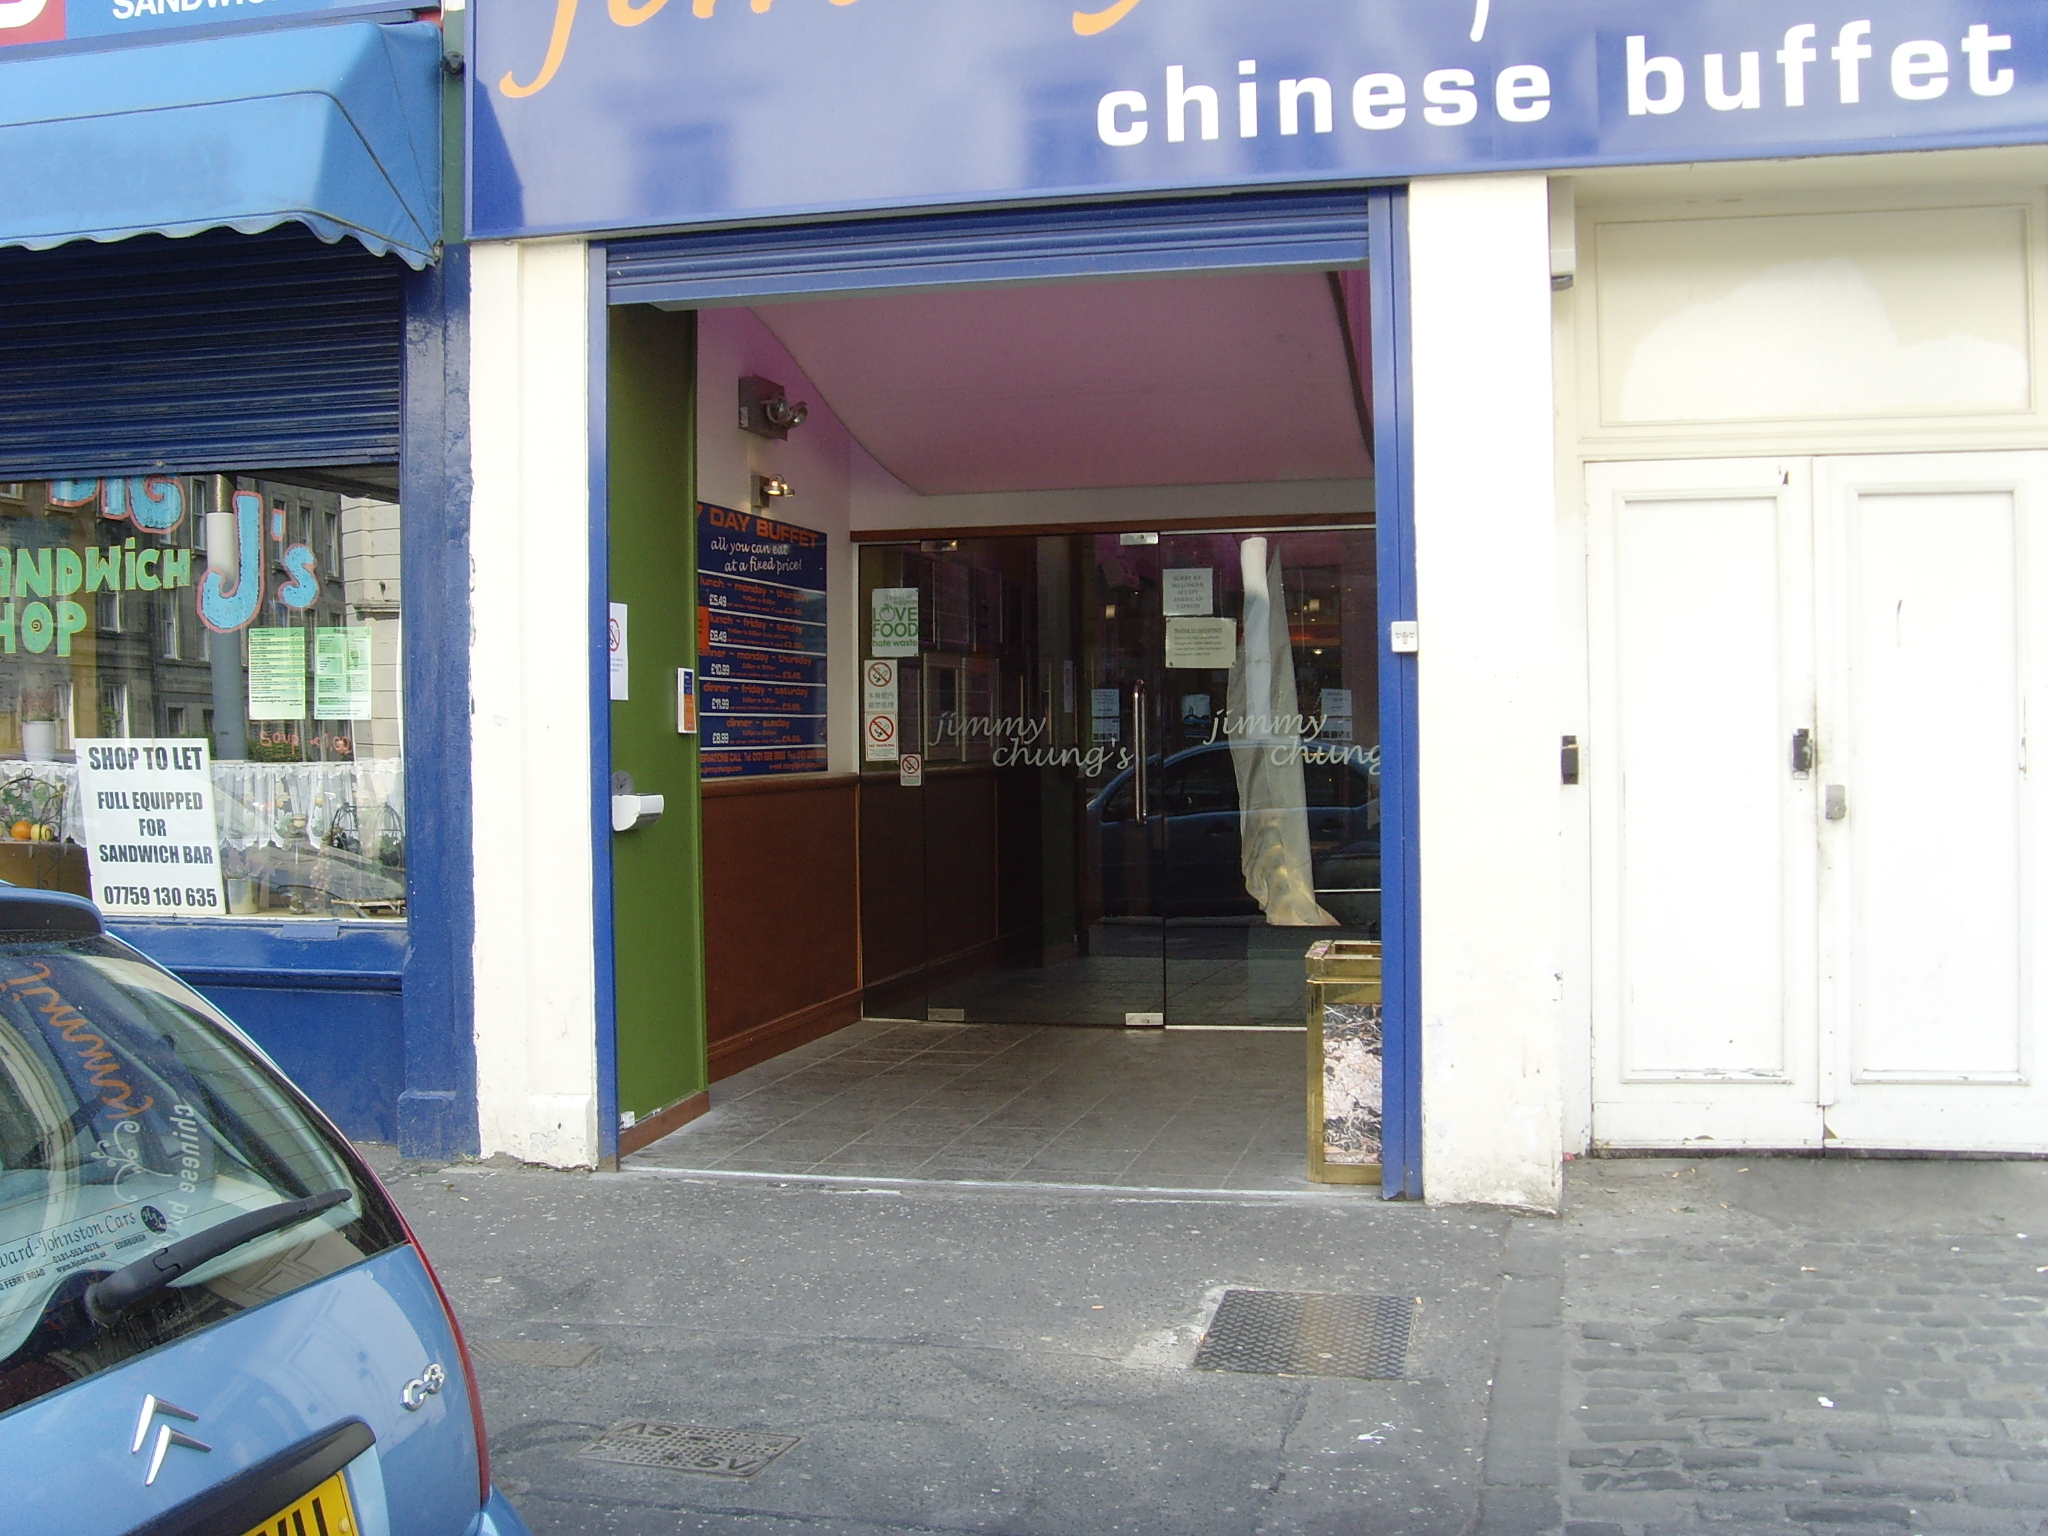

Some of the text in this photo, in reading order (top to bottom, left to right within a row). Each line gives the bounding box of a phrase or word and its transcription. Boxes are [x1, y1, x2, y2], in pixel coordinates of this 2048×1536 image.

[1097, 19, 2016, 147] chinese buffet
[710, 507, 750, 532] DAY
[756, 518, 819, 548] BUFFET
[711, 537, 789, 555] all you can eat
[725, 558, 738, 571] at
[739, 562, 748, 571] a
[750, 556, 775, 572] fixed
[872, 605, 918, 622] LOVE
[872, 622, 919, 638] FOOD
[872, 639, 918, 647] hate waste
[929, 710, 1047, 747] jimmy
[1203, 709, 1328, 745] jimmy
[88, 746, 203, 771] SHOP TO LET
[992, 736, 1134, 777] chung's
[97, 791, 204, 812] FULL EQUIPPED
[138, 818, 167, 837] FOR
[99, 844, 214, 864] SANDWICH BAR
[103, 885, 218, 907] 07759 130 635
[104, 1211, 137, 1234] Cars
[114, 1234, 148, 1251] EDINBURGH
[4, 1275, 26, 1292] FERRY
[27, 1268, 46, 1281] ROAD
[400, 1363, 446, 1411] C3
